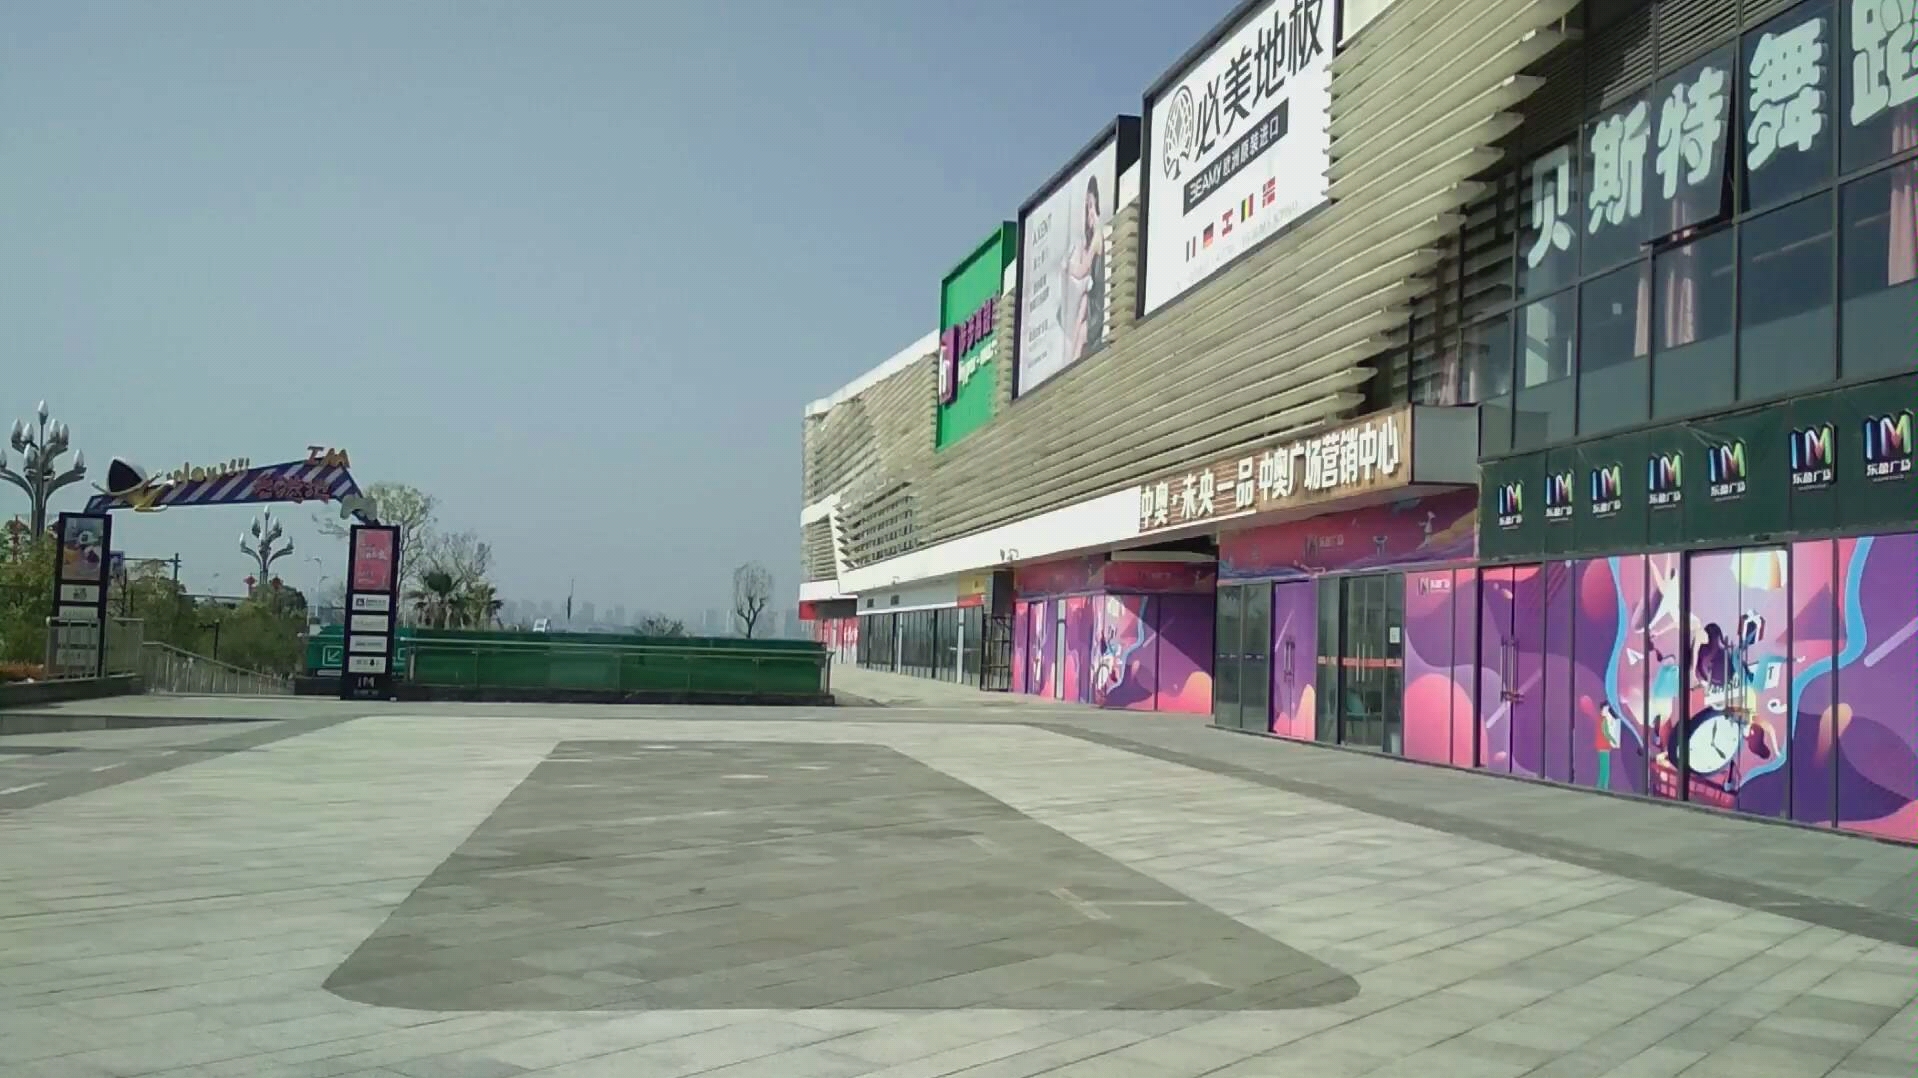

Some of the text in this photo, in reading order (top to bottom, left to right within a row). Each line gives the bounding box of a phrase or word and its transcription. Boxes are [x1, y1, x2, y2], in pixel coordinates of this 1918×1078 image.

[1194, 0, 1324, 161] 必美地板
[1222, 118, 1280, 178] 欧洲原装进口
